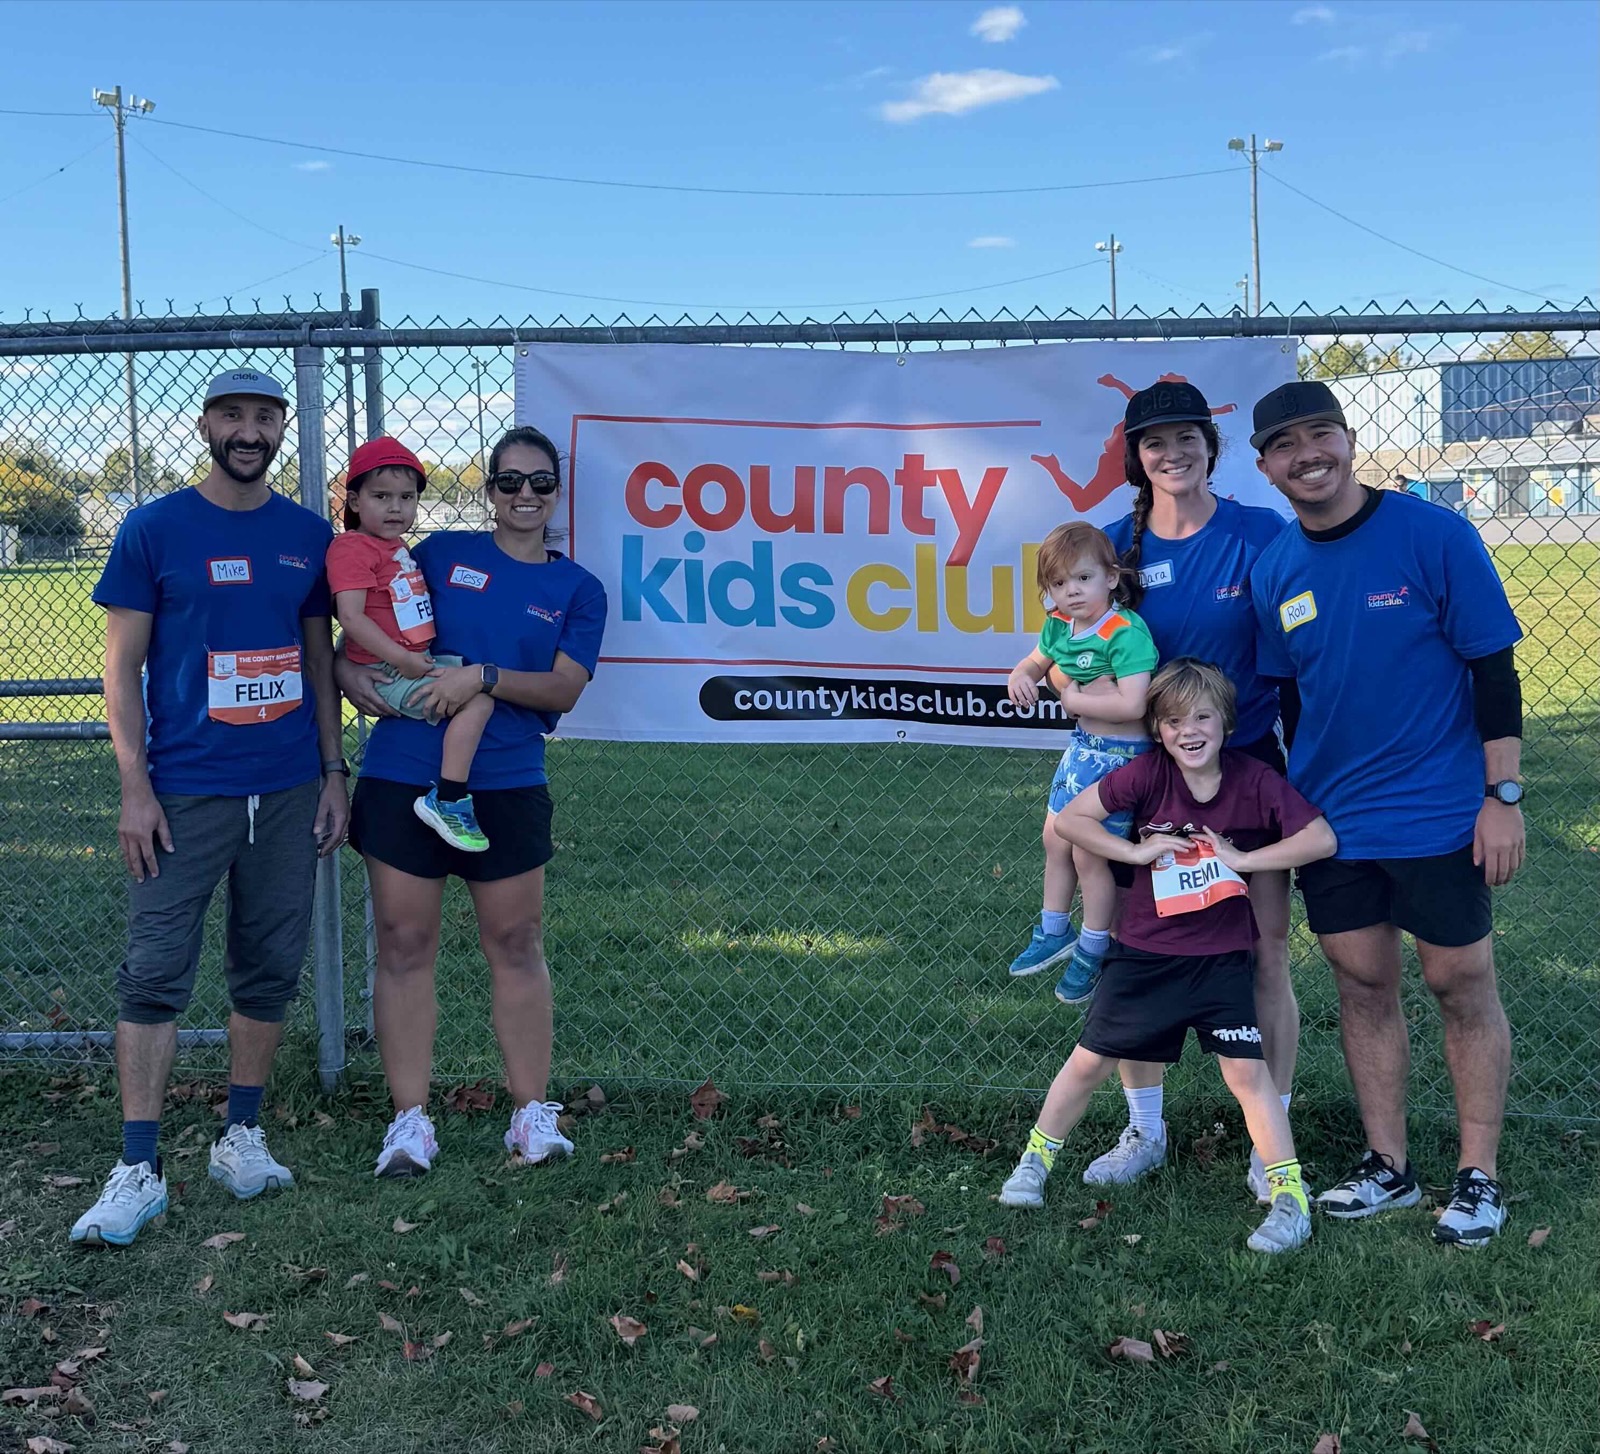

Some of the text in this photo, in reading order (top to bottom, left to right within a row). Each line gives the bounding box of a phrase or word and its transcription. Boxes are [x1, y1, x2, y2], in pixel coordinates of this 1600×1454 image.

[625, 453, 1008, 567] county
[216, 563, 246, 580] Mike
[454, 569, 483, 587] Jess
[847, 543, 1043, 633] clu
[1287, 602, 1306, 623] Rob
[252, 655, 275, 663] COUNTY
[235, 680, 285, 702] FELIX
[258, 706, 267, 719] 4
[734, 684, 1068, 720] countykidsclub.com
[1178, 861, 1220, 890] REMI
[1198, 889, 1212, 906] 17
